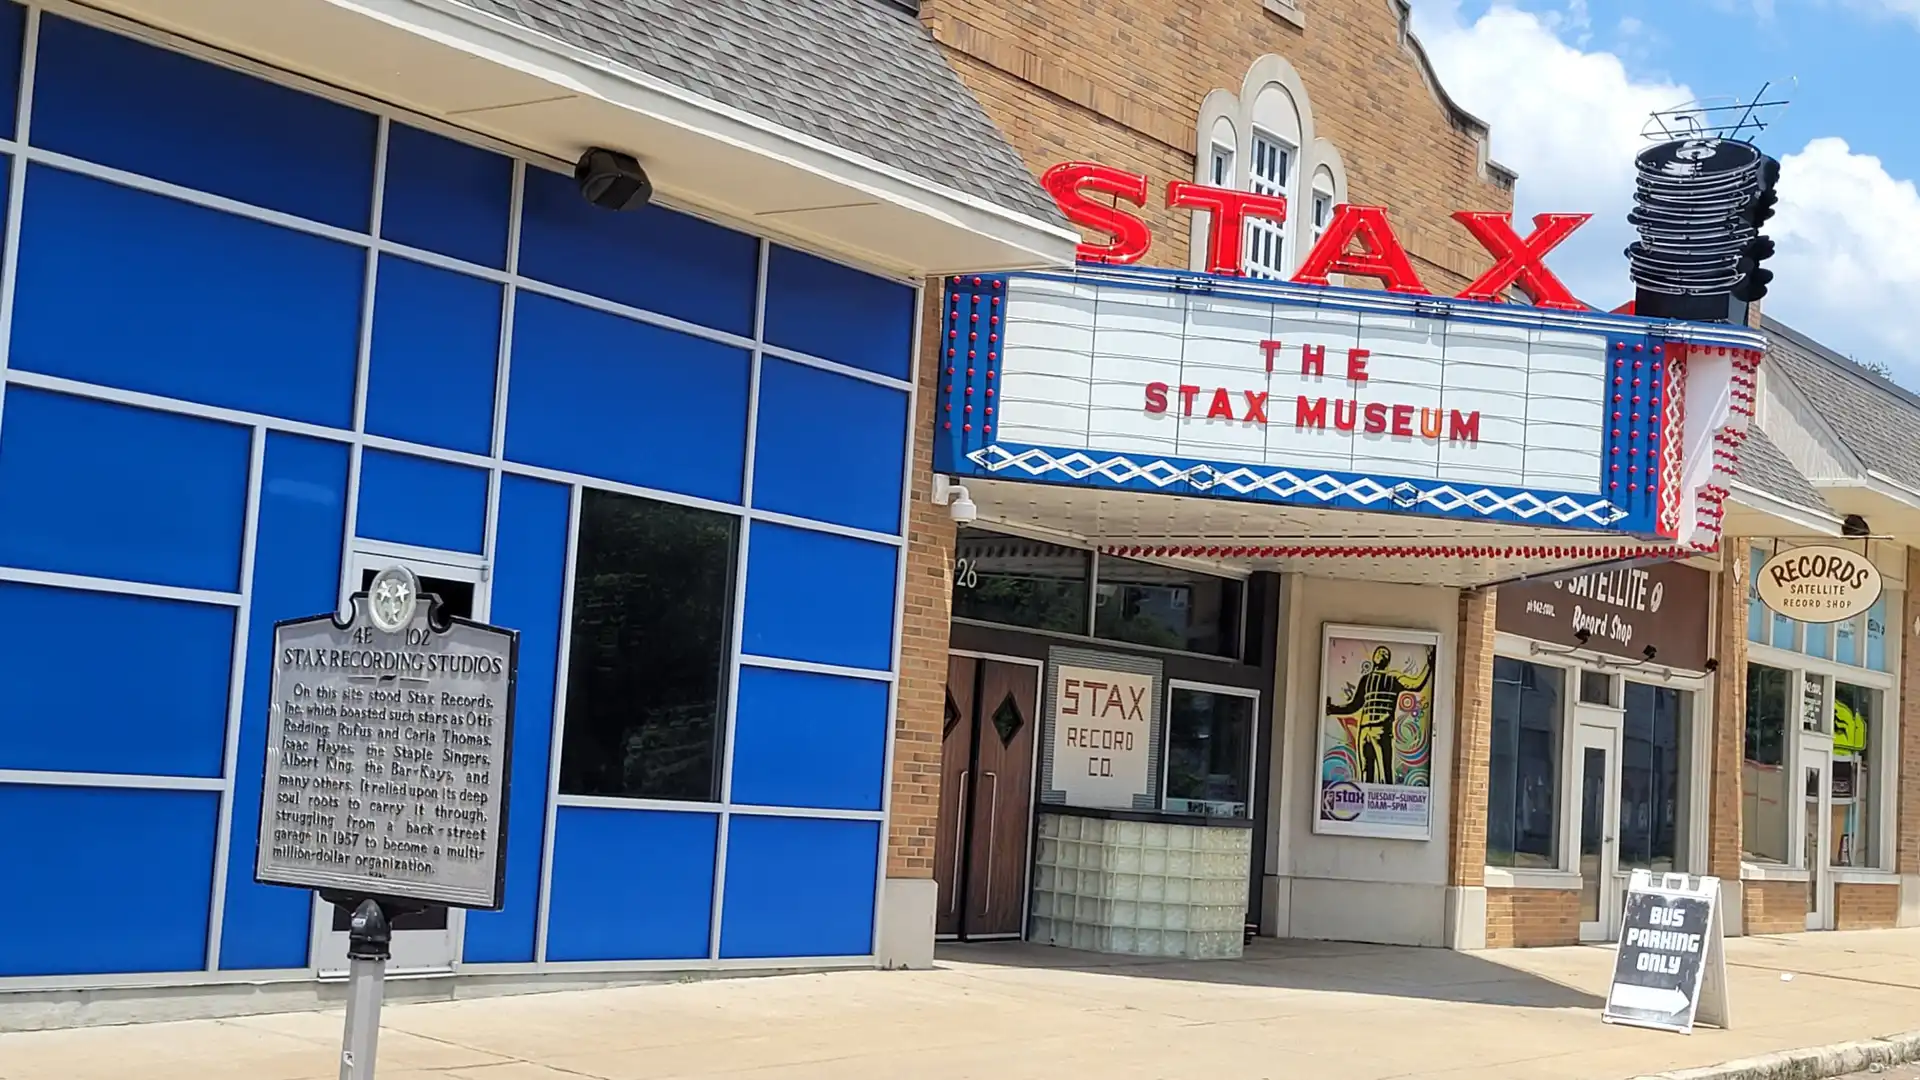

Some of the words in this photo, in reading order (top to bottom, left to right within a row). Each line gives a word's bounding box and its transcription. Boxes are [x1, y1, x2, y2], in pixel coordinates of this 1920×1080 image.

[1040, 160, 1594, 312] STAX
[1260, 340, 1370, 382] THE
[1144, 381, 1268, 424] STAX
[1295, 395, 1480, 444] MUSEUM
[956, 558, 977, 588] 26
[1770, 555, 1869, 589] RECORDS
[1784, 598, 1821, 608] RECORD
[1826, 600, 1851, 608] SHOP
[1790, 584, 1845, 595] SATELLITE
[353, 626, 372, 644] 4E
[406, 628, 430, 645] 102
[1572, 604, 1608, 636] Record
[1610, 614, 1632, 647] Shop
[284, 648, 326, 666] STAX
[330, 650, 423, 670] RECORDING
[428, 654, 502, 674] STUDIOS
[294, 682, 310, 696] On
[316, 686, 336, 698] this
[343, 688, 362, 699] site
[369, 689, 401, 702] stood
[408, 690, 434, 704] Stax
[1062, 679, 1145, 721] STAX
[307, 703, 336, 716] which
[340, 705, 386, 719] boasted
[390, 709, 414, 721] such
[418, 712, 448, 724] stars
[451, 715, 464, 725] as
[467, 711, 492, 726] Otis
[338, 723, 372, 737] Rufus
[378, 728, 399, 740] and
[405, 728, 435, 742] Carla
[1067, 728, 1133, 751] RECORD
[282, 736, 308, 751] Isaac
[367, 744, 385, 757] the
[394, 746, 433, 761] Staple
[443, 748, 490, 766] Singers,
[282, 752, 318, 768] Albert
[366, 760, 384, 773] the
[466, 771, 489, 784] and
[1089, 757, 1113, 778] CO.
[279, 774, 309, 789] many
[361, 778, 370, 792] It
[372, 781, 406, 796] relied
[410, 787, 438, 801] upon
[442, 787, 456, 800] its
[460, 788, 488, 805] deep
[276, 810, 335, 828] struggling
[347, 814, 375, 830] from
[387, 821, 393, 832] a
[277, 792, 299, 804] soul
[308, 795, 339, 808] roots
[348, 797, 360, 809] to
[370, 801, 405, 815] carry
[415, 804, 424, 816] it
[435, 805, 487, 824] through,
[274, 830, 311, 842] garage
[317, 830, 328, 843] in
[334, 831, 359, 847] 1957
[366, 836, 377, 848] to
[384, 836, 428, 853] become
[434, 845, 440, 855] a
[447, 845, 485, 859] multi-
[273, 845, 350, 864] million-dollar
[355, 855, 435, 874] organization.
[1650, 906, 1685, 927] BUS
[1627, 928, 1700, 952] PARKING
[1637, 952, 1681, 974] ONLY
